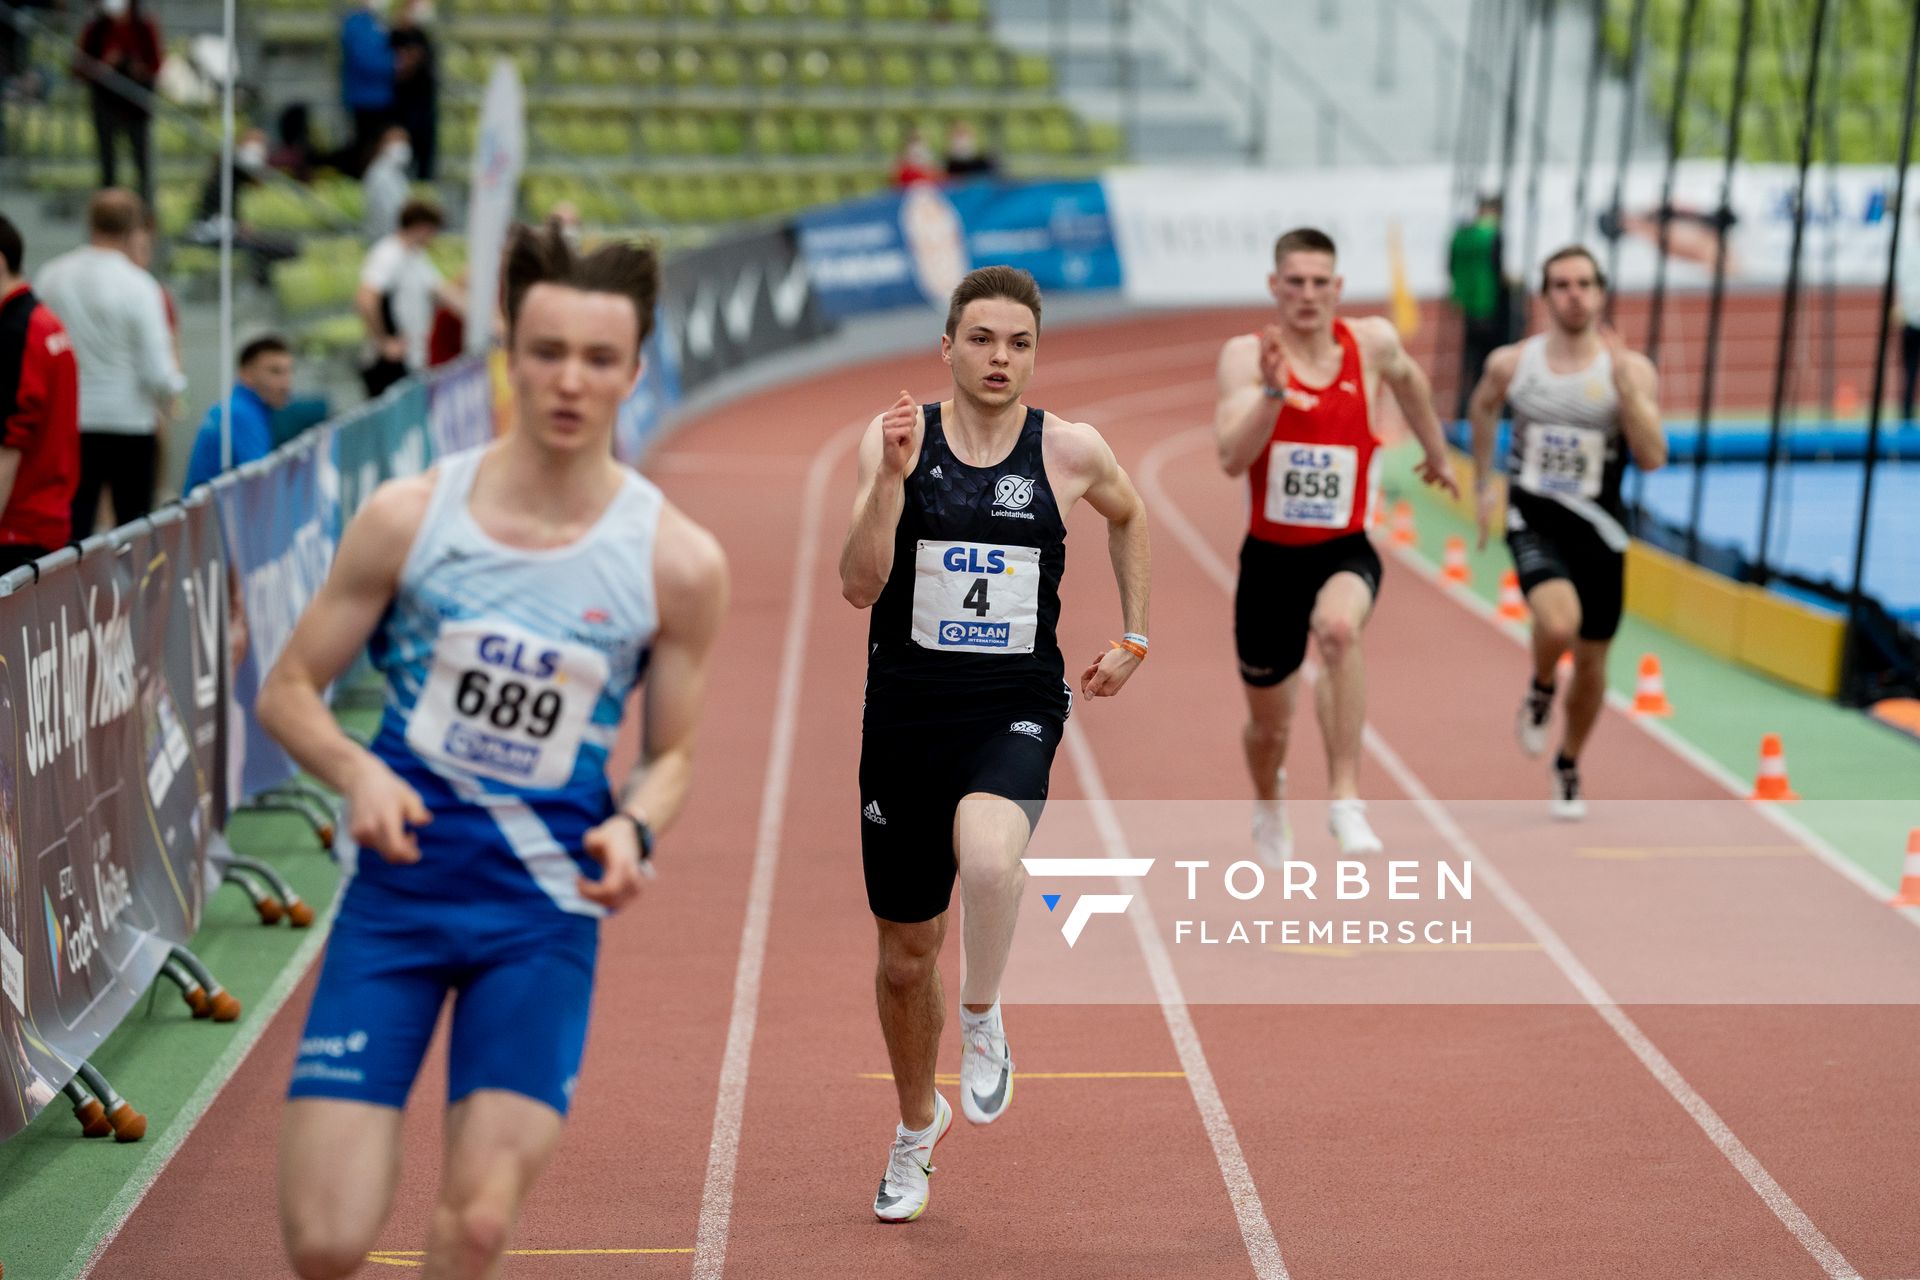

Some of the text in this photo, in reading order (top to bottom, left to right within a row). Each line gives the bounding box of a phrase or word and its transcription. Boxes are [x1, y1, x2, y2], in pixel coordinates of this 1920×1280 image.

[993, 476, 1034, 509] 96
[1283, 470, 1340, 499] 658
[991, 509, 1035, 520] Leichtathletik
[962, 577, 990, 618] 4
[968, 626, 1007, 639] PLAN
[453, 669, 563, 739] 689
[863, 808, 888, 826] adidas
